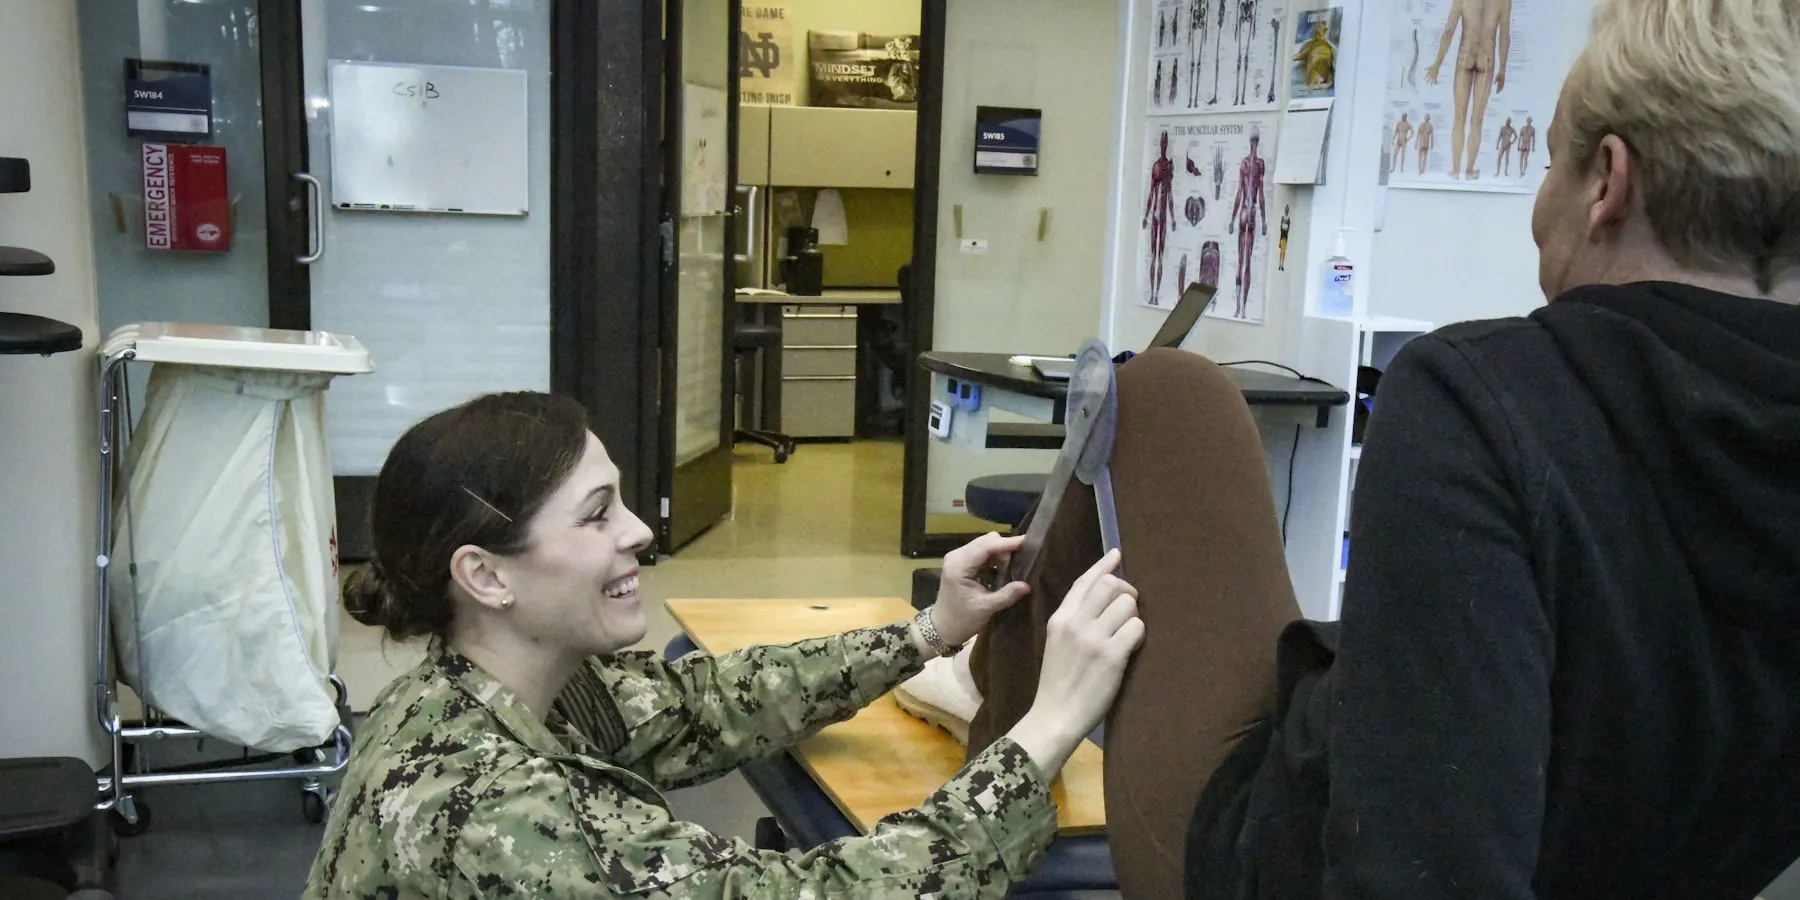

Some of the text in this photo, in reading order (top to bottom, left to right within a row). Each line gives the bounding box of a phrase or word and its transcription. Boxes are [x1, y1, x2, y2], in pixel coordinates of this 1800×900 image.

[813, 62, 877, 77] MINDSET
[826, 75, 883, 84] EVERYTHING
[134, 90, 163, 100] SW184
[766, 92, 792, 104] IRISH
[1174, 124, 1243, 136] THE MUSCULAR SYSTEM
[145, 145, 167, 247] EMERGENCY
